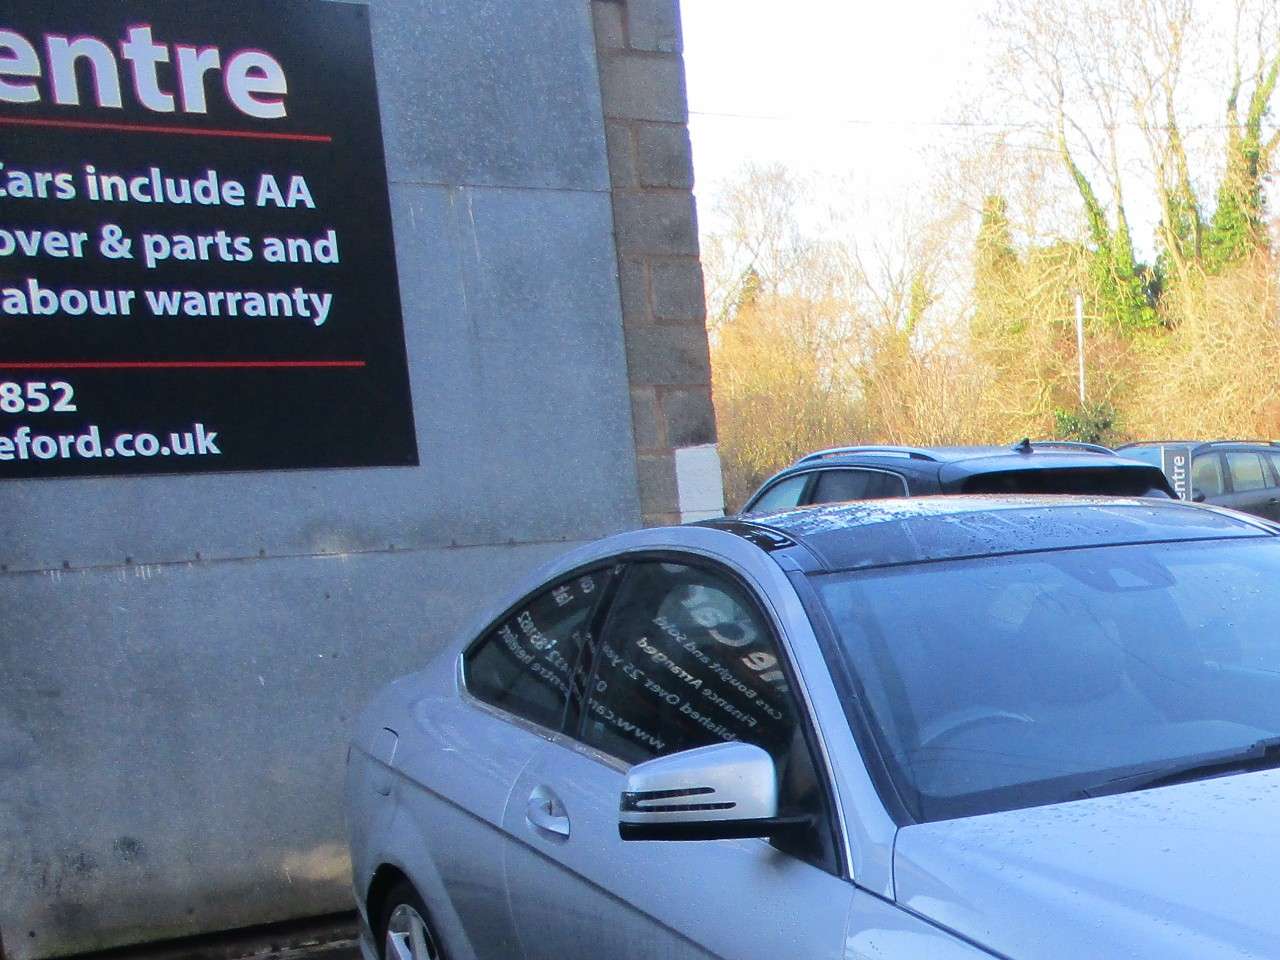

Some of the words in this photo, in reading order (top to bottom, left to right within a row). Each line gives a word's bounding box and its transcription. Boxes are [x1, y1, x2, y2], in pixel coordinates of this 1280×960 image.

[86, 164, 246, 207] include
[256, 174, 316, 209] AA
[0, 228, 88, 258] over
[99, 224, 134, 260] &
[143, 229, 254, 268] parts
[262, 230, 340, 264] and
[1, 278, 136, 316] abour
[145, 286, 333, 326] warranty
